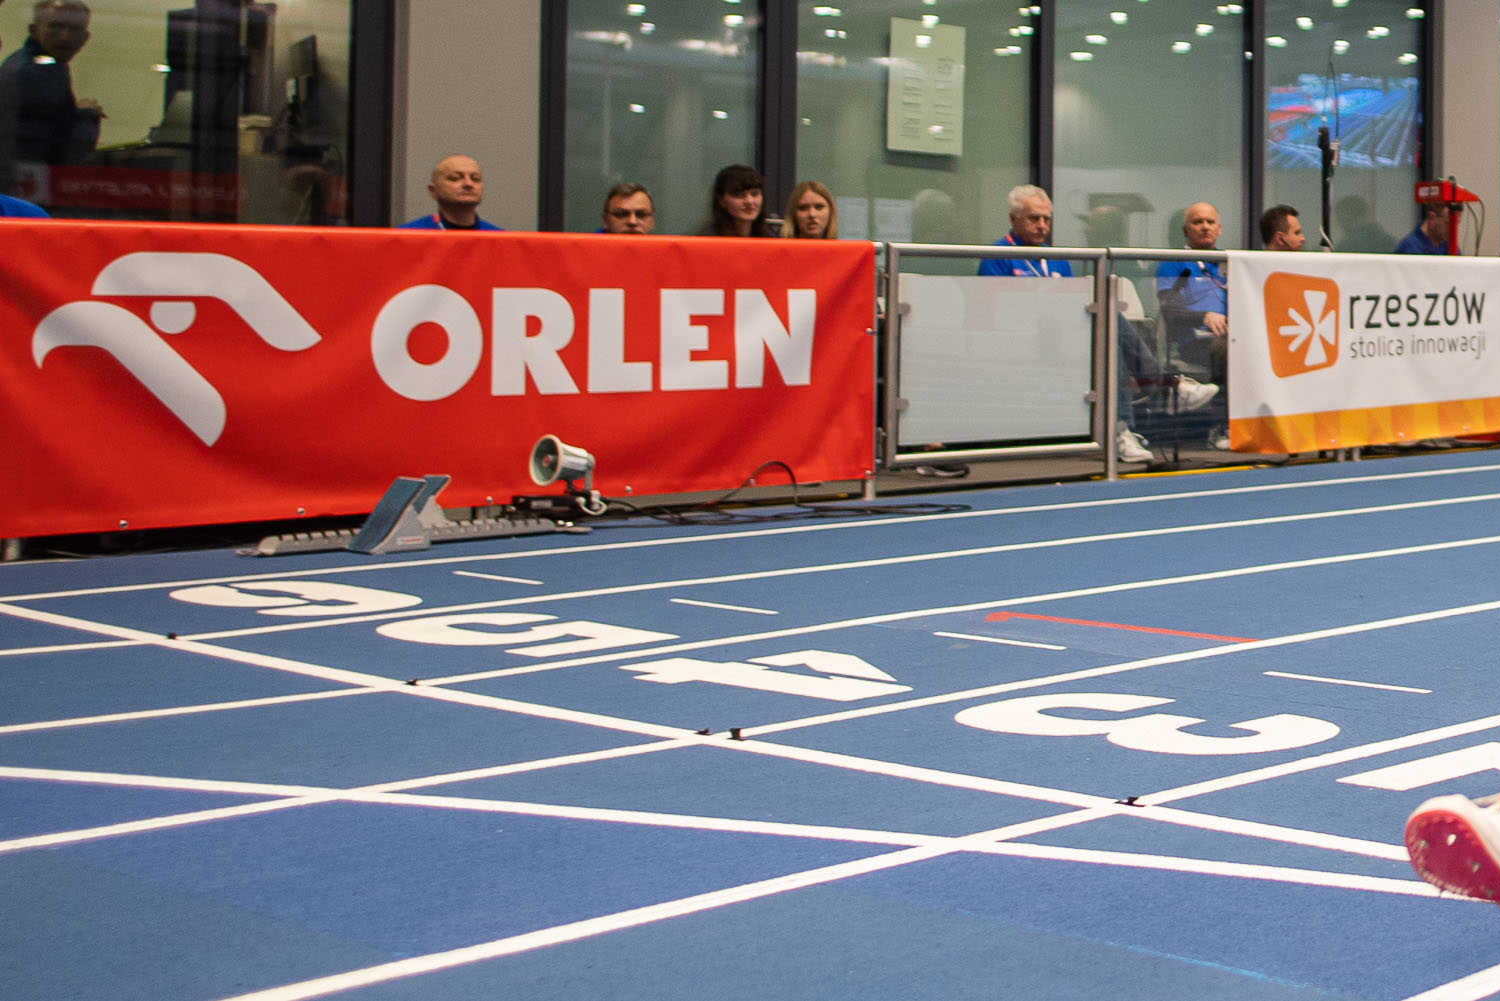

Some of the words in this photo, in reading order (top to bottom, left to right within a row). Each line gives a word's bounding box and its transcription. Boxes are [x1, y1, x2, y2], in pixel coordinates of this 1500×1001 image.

[1349, 285, 1486, 330] rzeszów
[371, 284, 817, 401] ORLEN
[1351, 335, 1404, 359] stolica
[1411, 330, 1487, 360] innowacji
[376, 613, 682, 658] 5
[619, 649, 914, 702] 4
[954, 692, 1341, 756] 3
